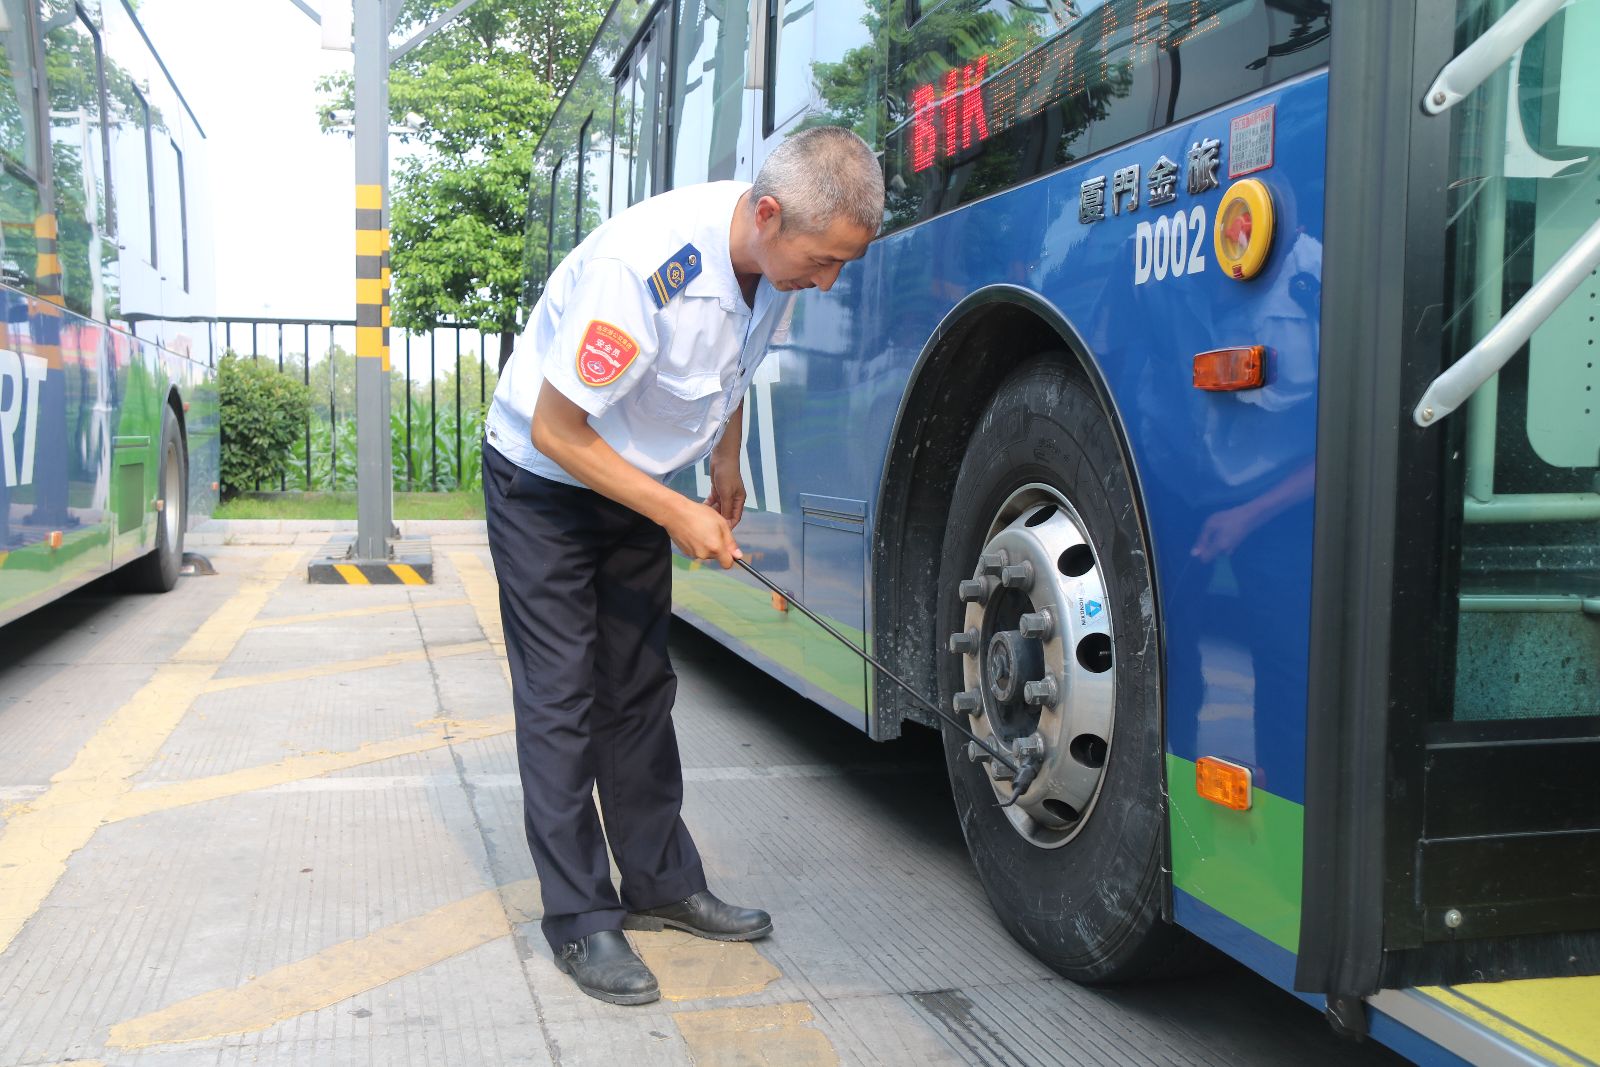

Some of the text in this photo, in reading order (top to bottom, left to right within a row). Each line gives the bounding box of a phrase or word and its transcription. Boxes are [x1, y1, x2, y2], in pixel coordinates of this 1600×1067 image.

[914, 54, 988, 173] B1K
[1135, 205, 1206, 285] D002
[596, 338, 621, 358] 安全员
